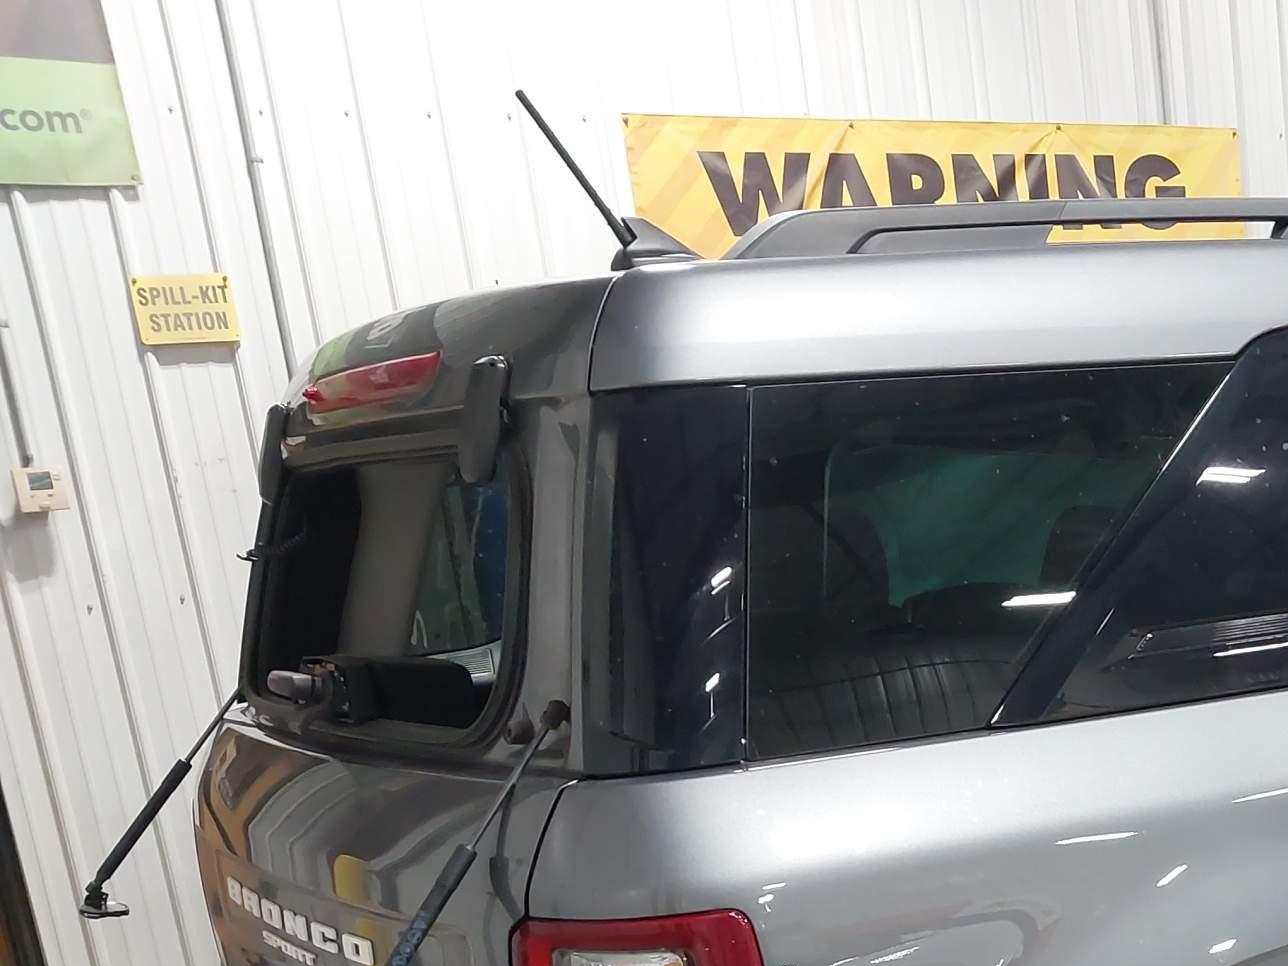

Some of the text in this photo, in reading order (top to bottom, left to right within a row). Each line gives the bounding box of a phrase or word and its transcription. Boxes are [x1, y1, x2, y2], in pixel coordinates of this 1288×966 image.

[697, 151, 1187, 236] WARNING
[136, 285, 228, 306] SPILL-KIT
[149, 311, 229, 332] STATION
[227, 876, 375, 966] BRONCO
[262, 930, 317, 966] SPORT
